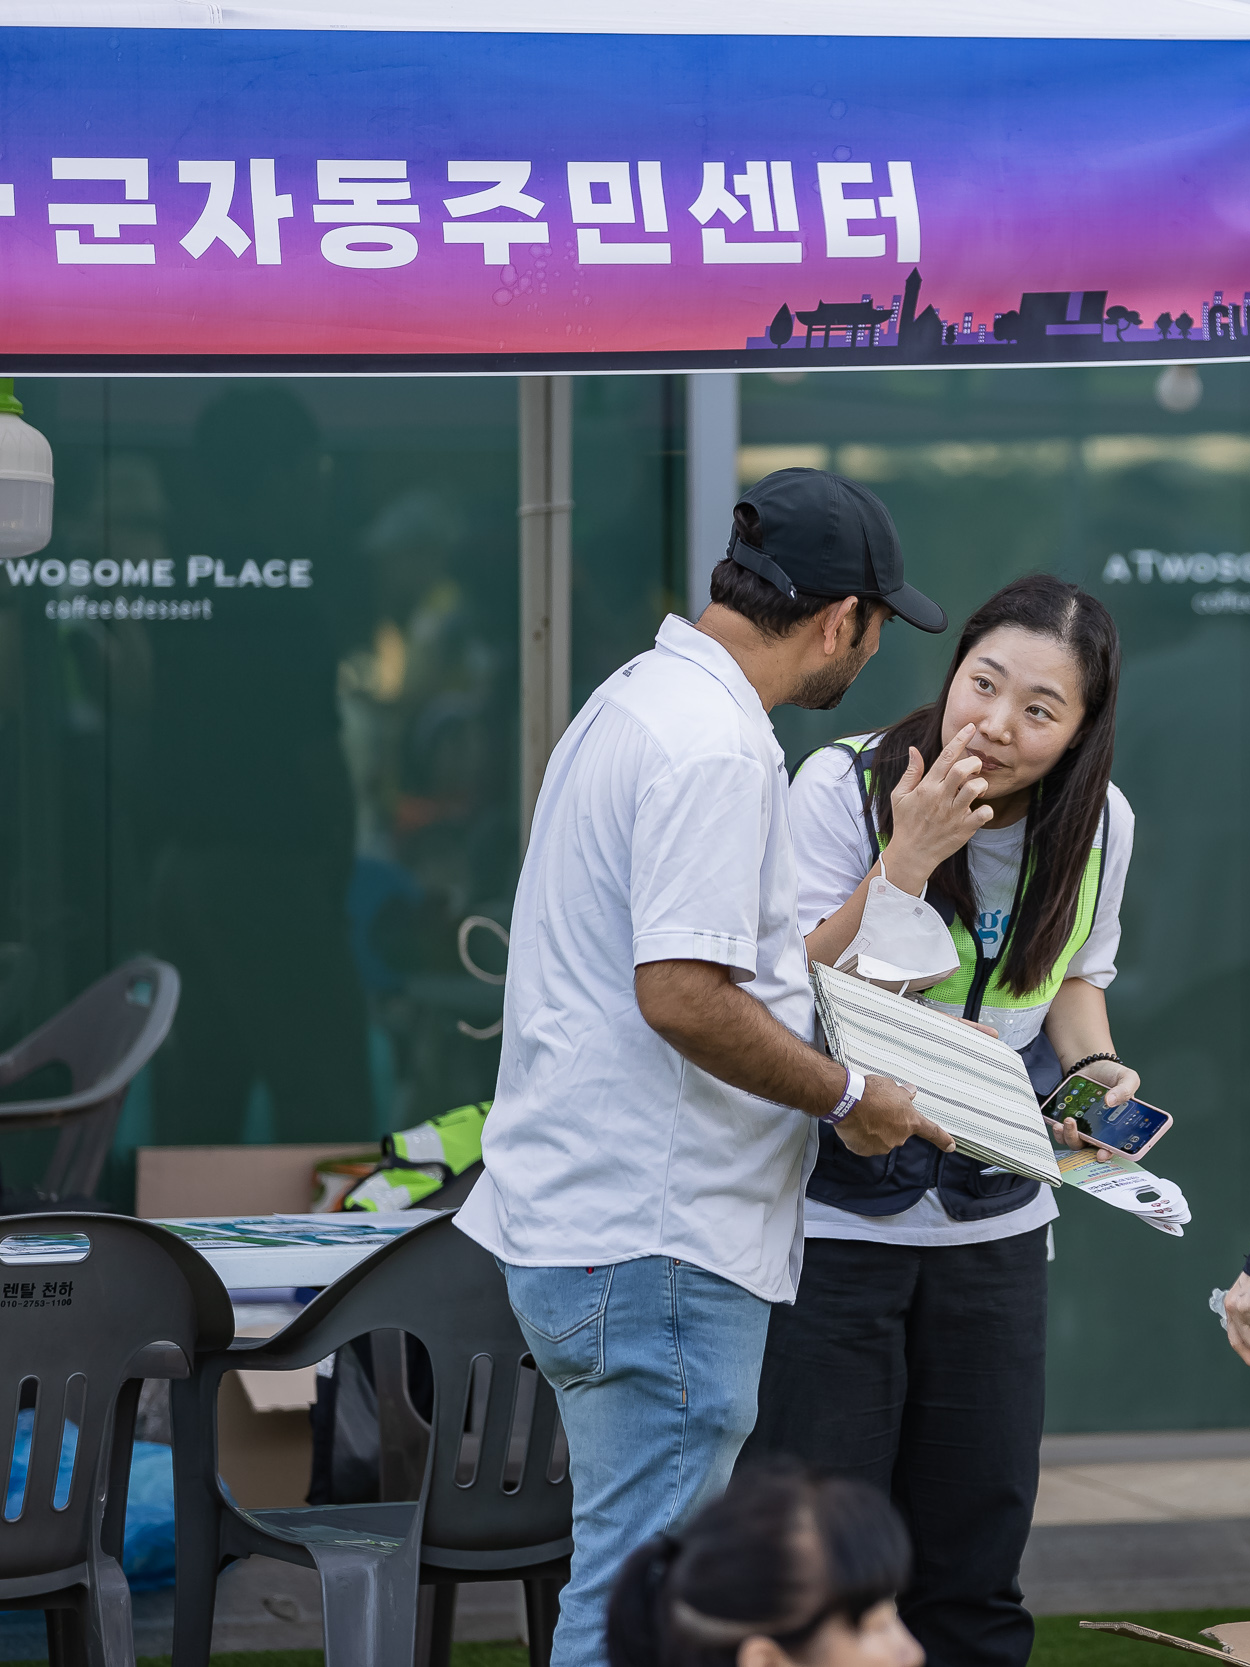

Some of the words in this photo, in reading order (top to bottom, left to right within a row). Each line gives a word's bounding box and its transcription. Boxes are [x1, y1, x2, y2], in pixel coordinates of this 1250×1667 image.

[48, 157, 921, 269] 군자동주민센터
[0, 558, 175, 588] WOSOME
[186, 554, 314, 588] PLACE
[3, 1282, 36, 1299] 렌탈
[42, 1280, 73, 1298] 천하
